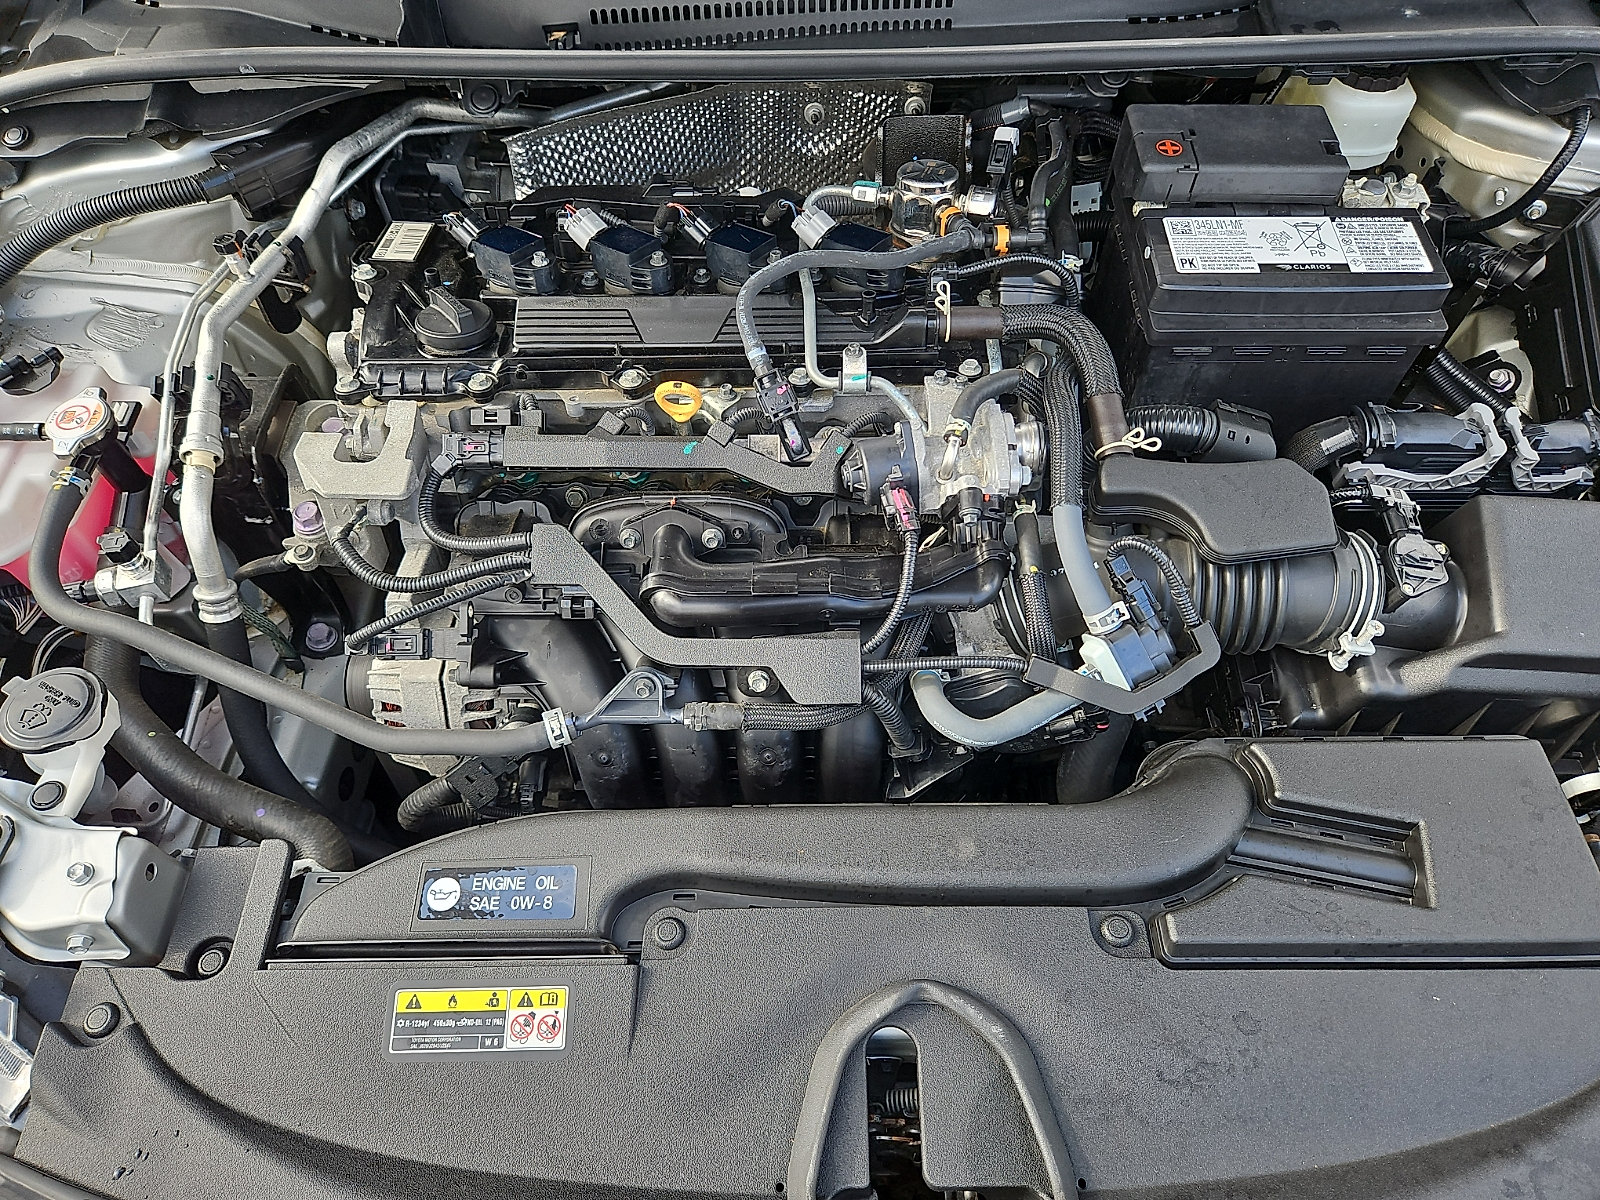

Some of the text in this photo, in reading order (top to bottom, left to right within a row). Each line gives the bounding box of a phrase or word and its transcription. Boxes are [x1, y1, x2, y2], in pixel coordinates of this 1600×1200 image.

[1194, 219, 1244, 230] 345LN1-MF
[1310, 249, 1326, 257] Pb
[1179, 258, 1197, 269] PK
[472, 875, 559, 891] ENGINE OIL
[469, 895, 553, 911] SAE 0W-8
